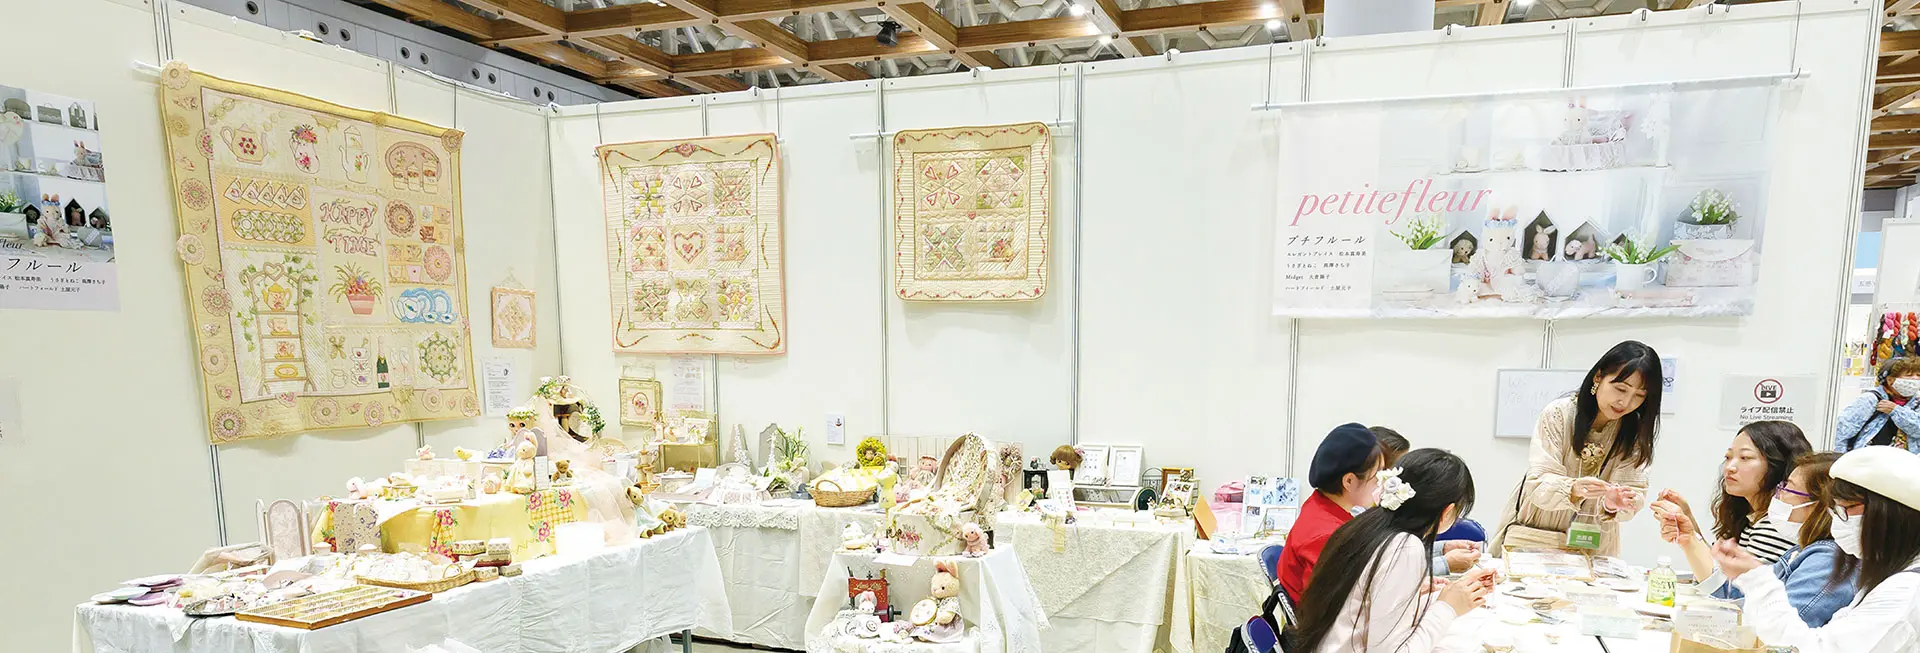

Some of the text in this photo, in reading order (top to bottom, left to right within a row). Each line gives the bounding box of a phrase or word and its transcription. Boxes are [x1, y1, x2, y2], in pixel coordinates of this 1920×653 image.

[1288, 178, 1492, 226] petitefleur
[320, 202, 377, 235] HAPPY
[329, 235, 378, 256] TIME
[1287, 235, 1366, 246] プチフルール
[1740, 406, 1794, 414] ライブ配信禁止
